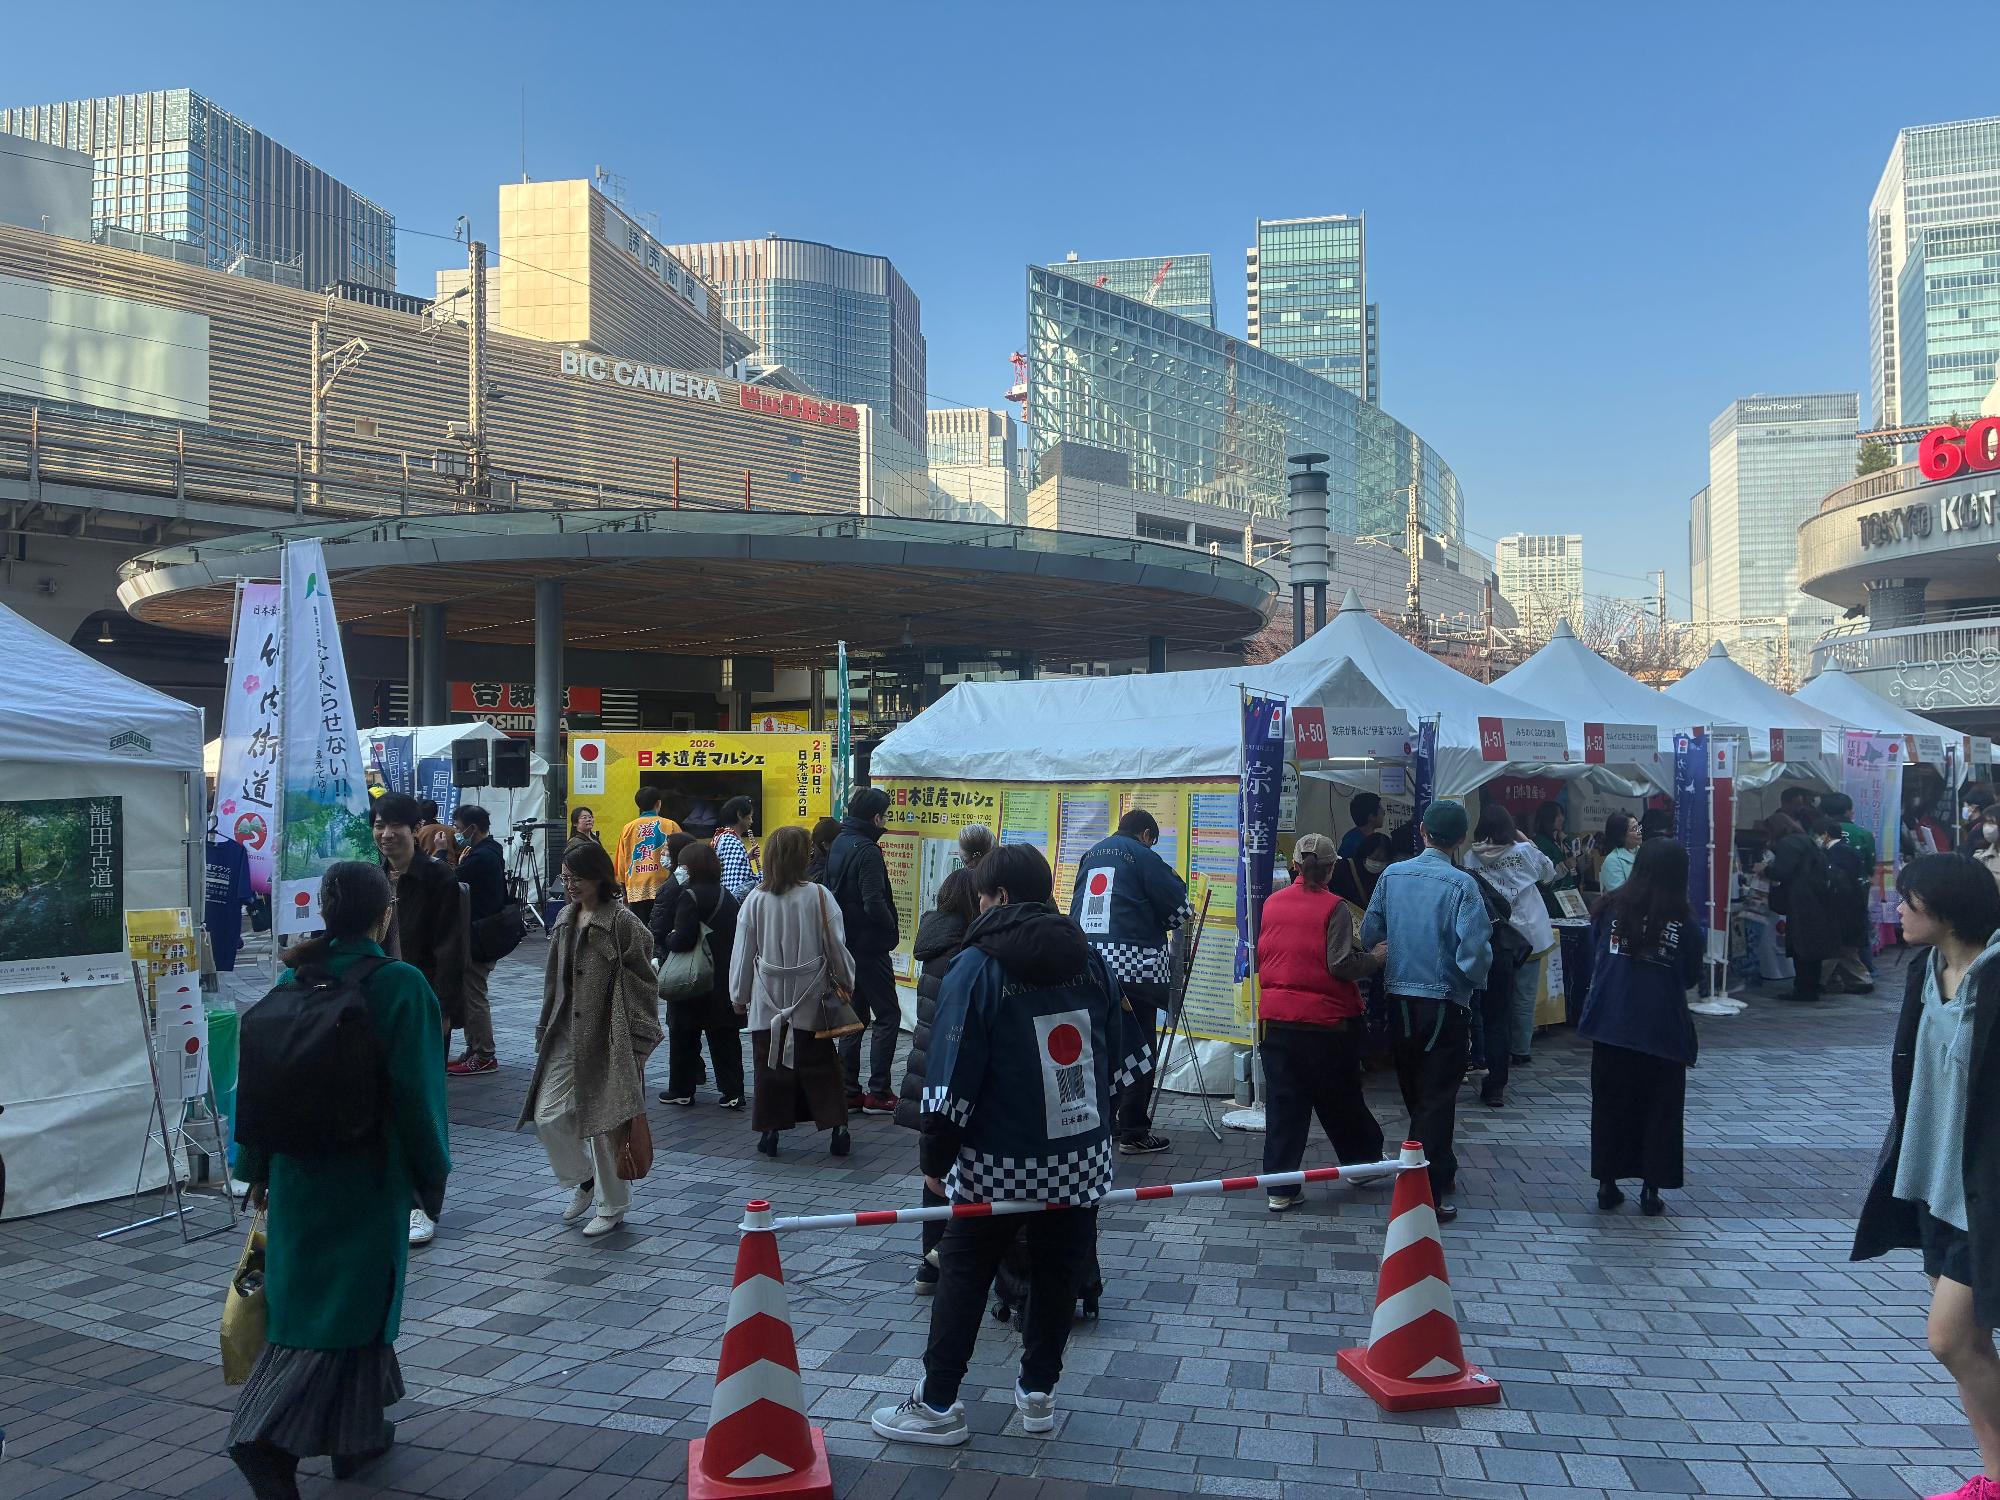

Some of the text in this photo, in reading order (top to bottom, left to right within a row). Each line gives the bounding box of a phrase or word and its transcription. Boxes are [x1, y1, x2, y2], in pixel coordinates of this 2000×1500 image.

[561, 349, 721, 403] BIC CAMERA
[1857, 489, 2000, 551] TOKYO KOT
[253, 604, 281, 616] 日本最
[471, 682, 571, 709] 吉野
[472, 714, 569, 731] YOSHINA
[1298, 723, 1324, 742] A-50
[689, 739, 715, 749] 2026
[1484, 730, 1502, 748] A-51
[1586, 735, 1603, 751] A-52
[638, 750, 765, 767] 日本遺産マルシェ
[810, 740, 823, 794] 2月13日は
[797, 750, 809, 816] 日本遺産の日
[897, 786, 994, 808] 日本遺産マルシェ
[89, 804, 114, 888] 龍田古道
[637, 821, 656, 862] 滋賀
[635, 863, 659, 873] SHIGA
